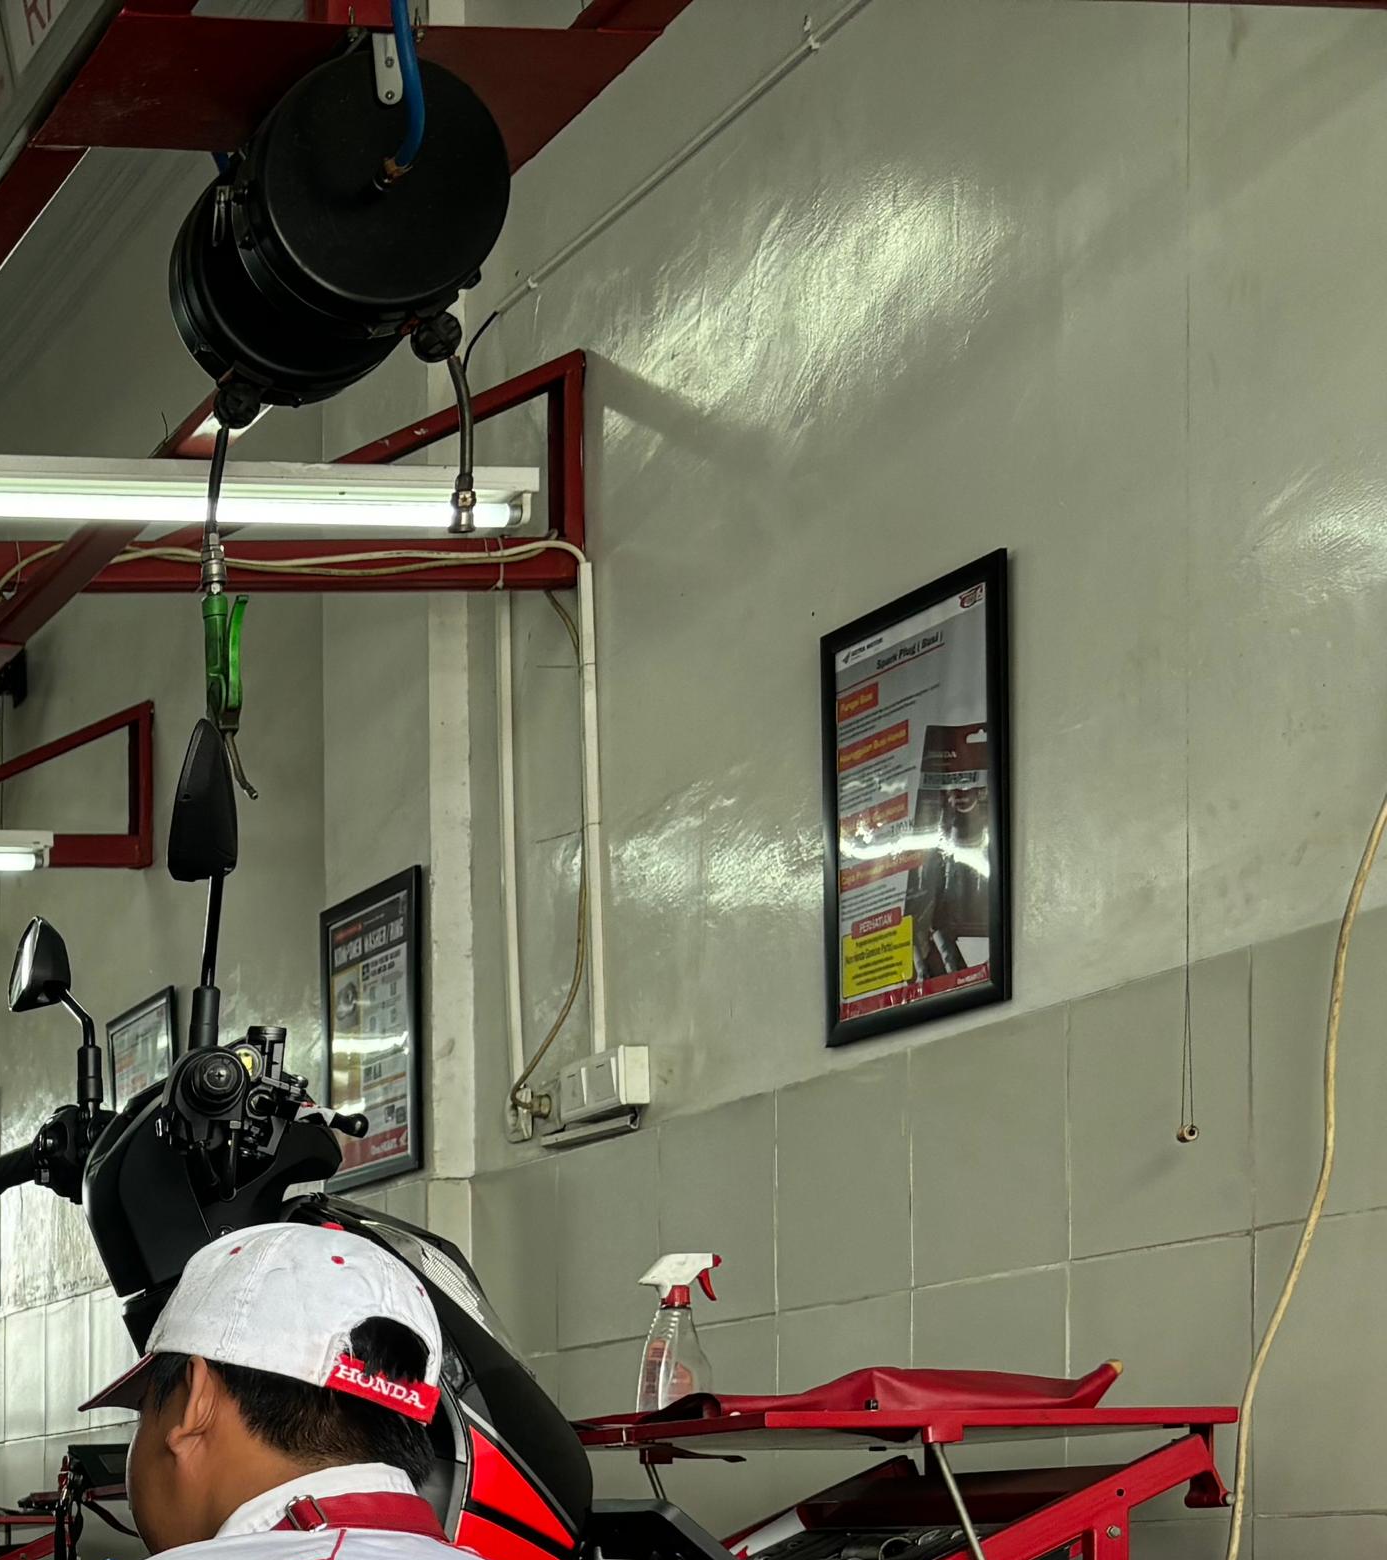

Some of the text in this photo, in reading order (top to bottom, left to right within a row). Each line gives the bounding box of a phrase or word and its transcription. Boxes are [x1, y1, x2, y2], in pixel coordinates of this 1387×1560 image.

[898, 643, 916, 660] Plug
[858, 912, 893, 934] PERHATIAN
[334, 1364, 426, 1409] HONDA
